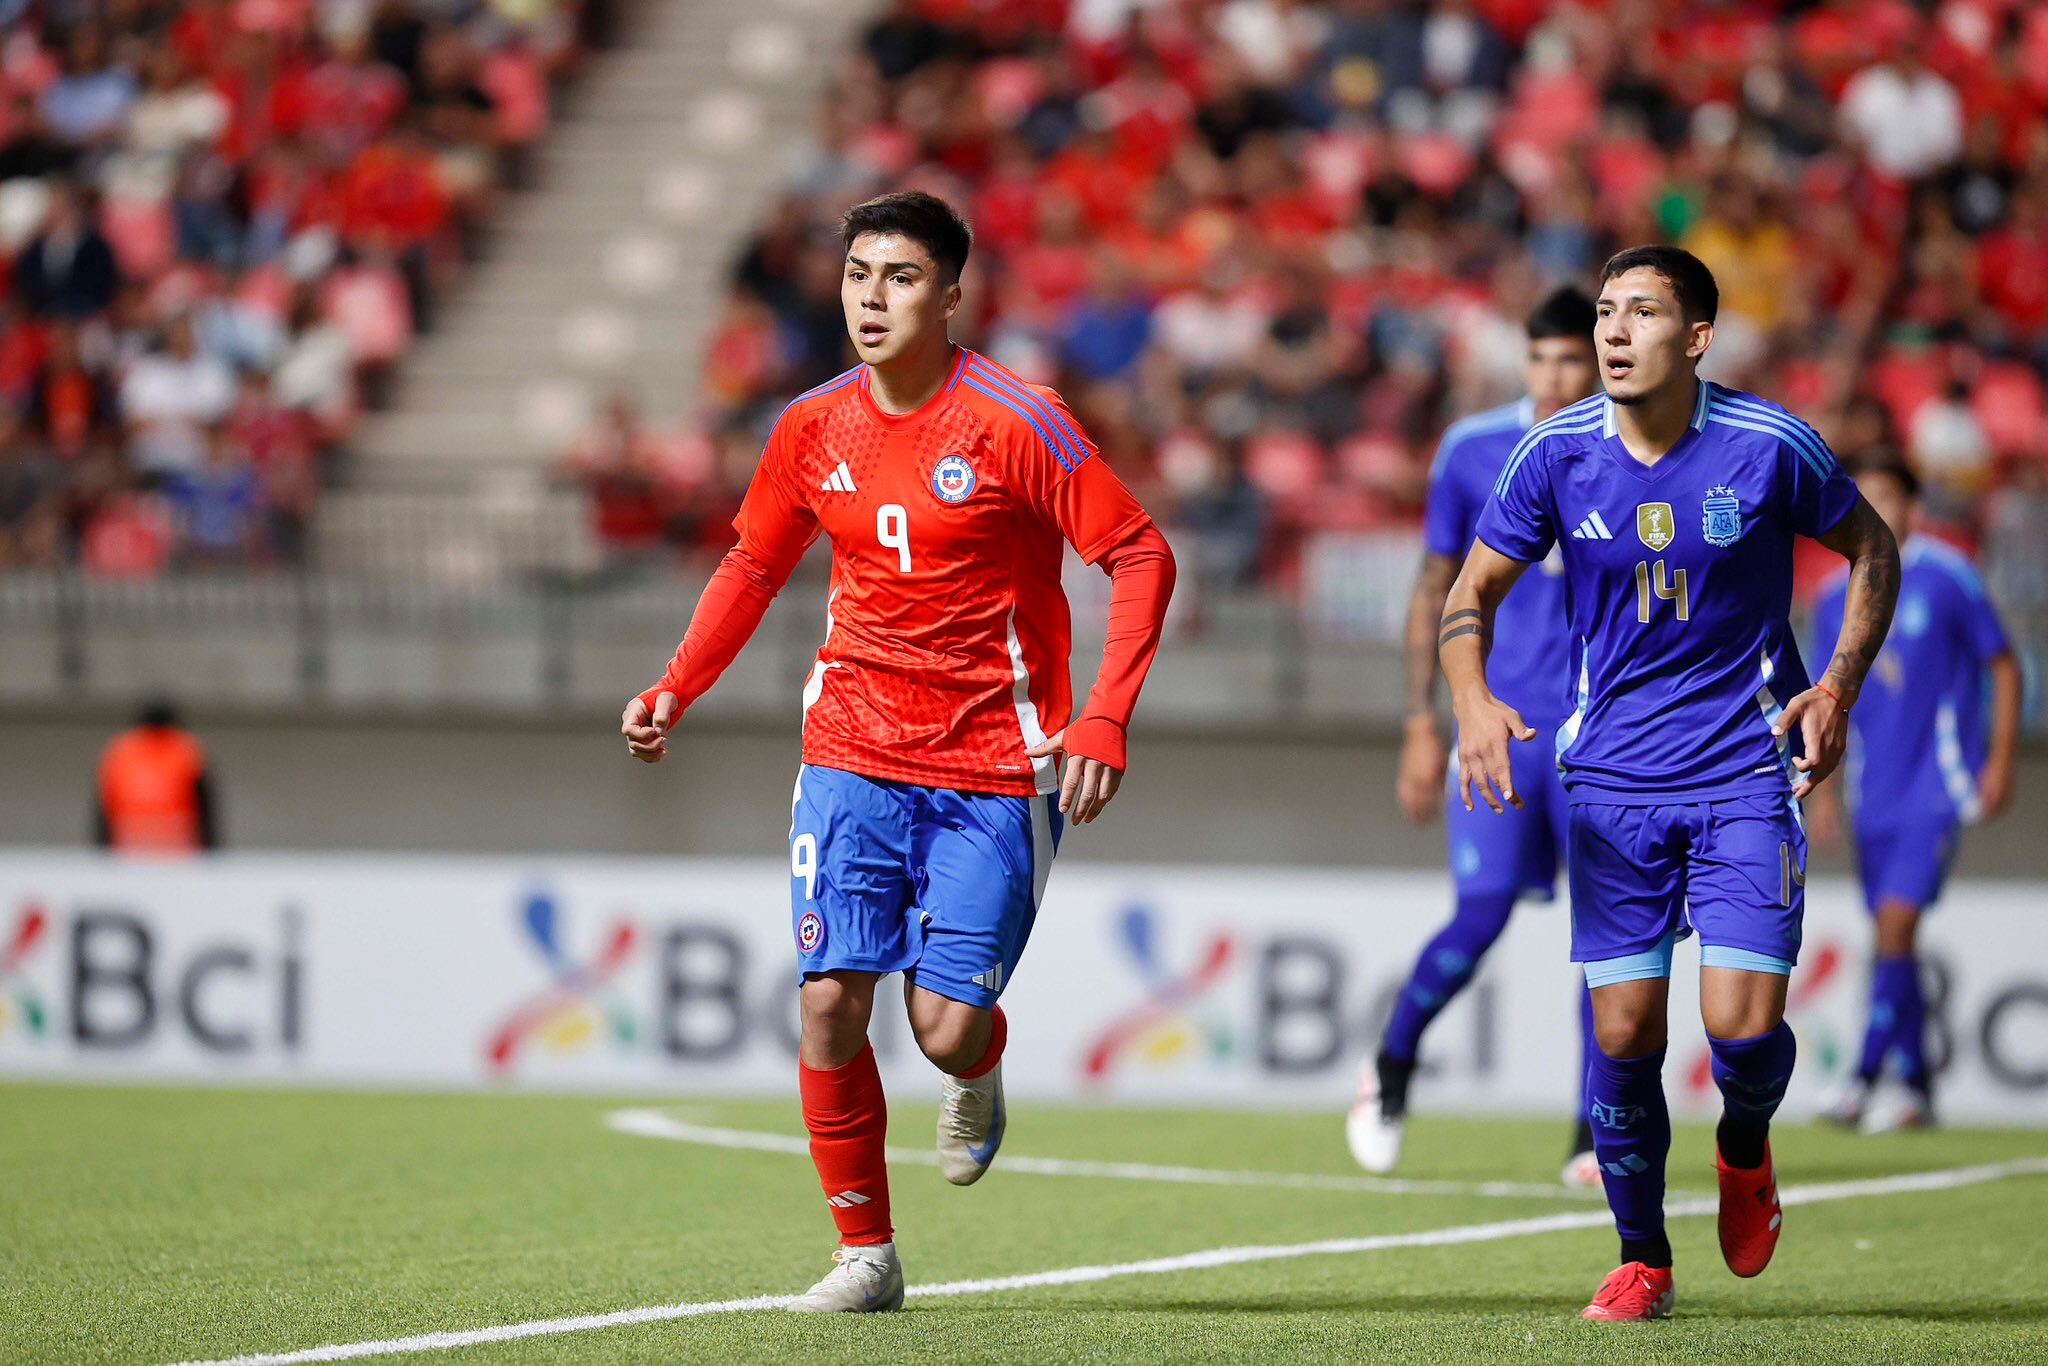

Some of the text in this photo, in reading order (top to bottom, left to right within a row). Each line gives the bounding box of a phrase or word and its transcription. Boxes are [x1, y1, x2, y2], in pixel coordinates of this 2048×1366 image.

[876, 503, 912, 573] 9
[1711, 511, 1734, 532] AFA
[1634, 559, 1689, 624] 14
[791, 832, 817, 901] 9
[69, 902, 307, 1056] Bci
[1590, 1095, 1647, 1130] AFA
